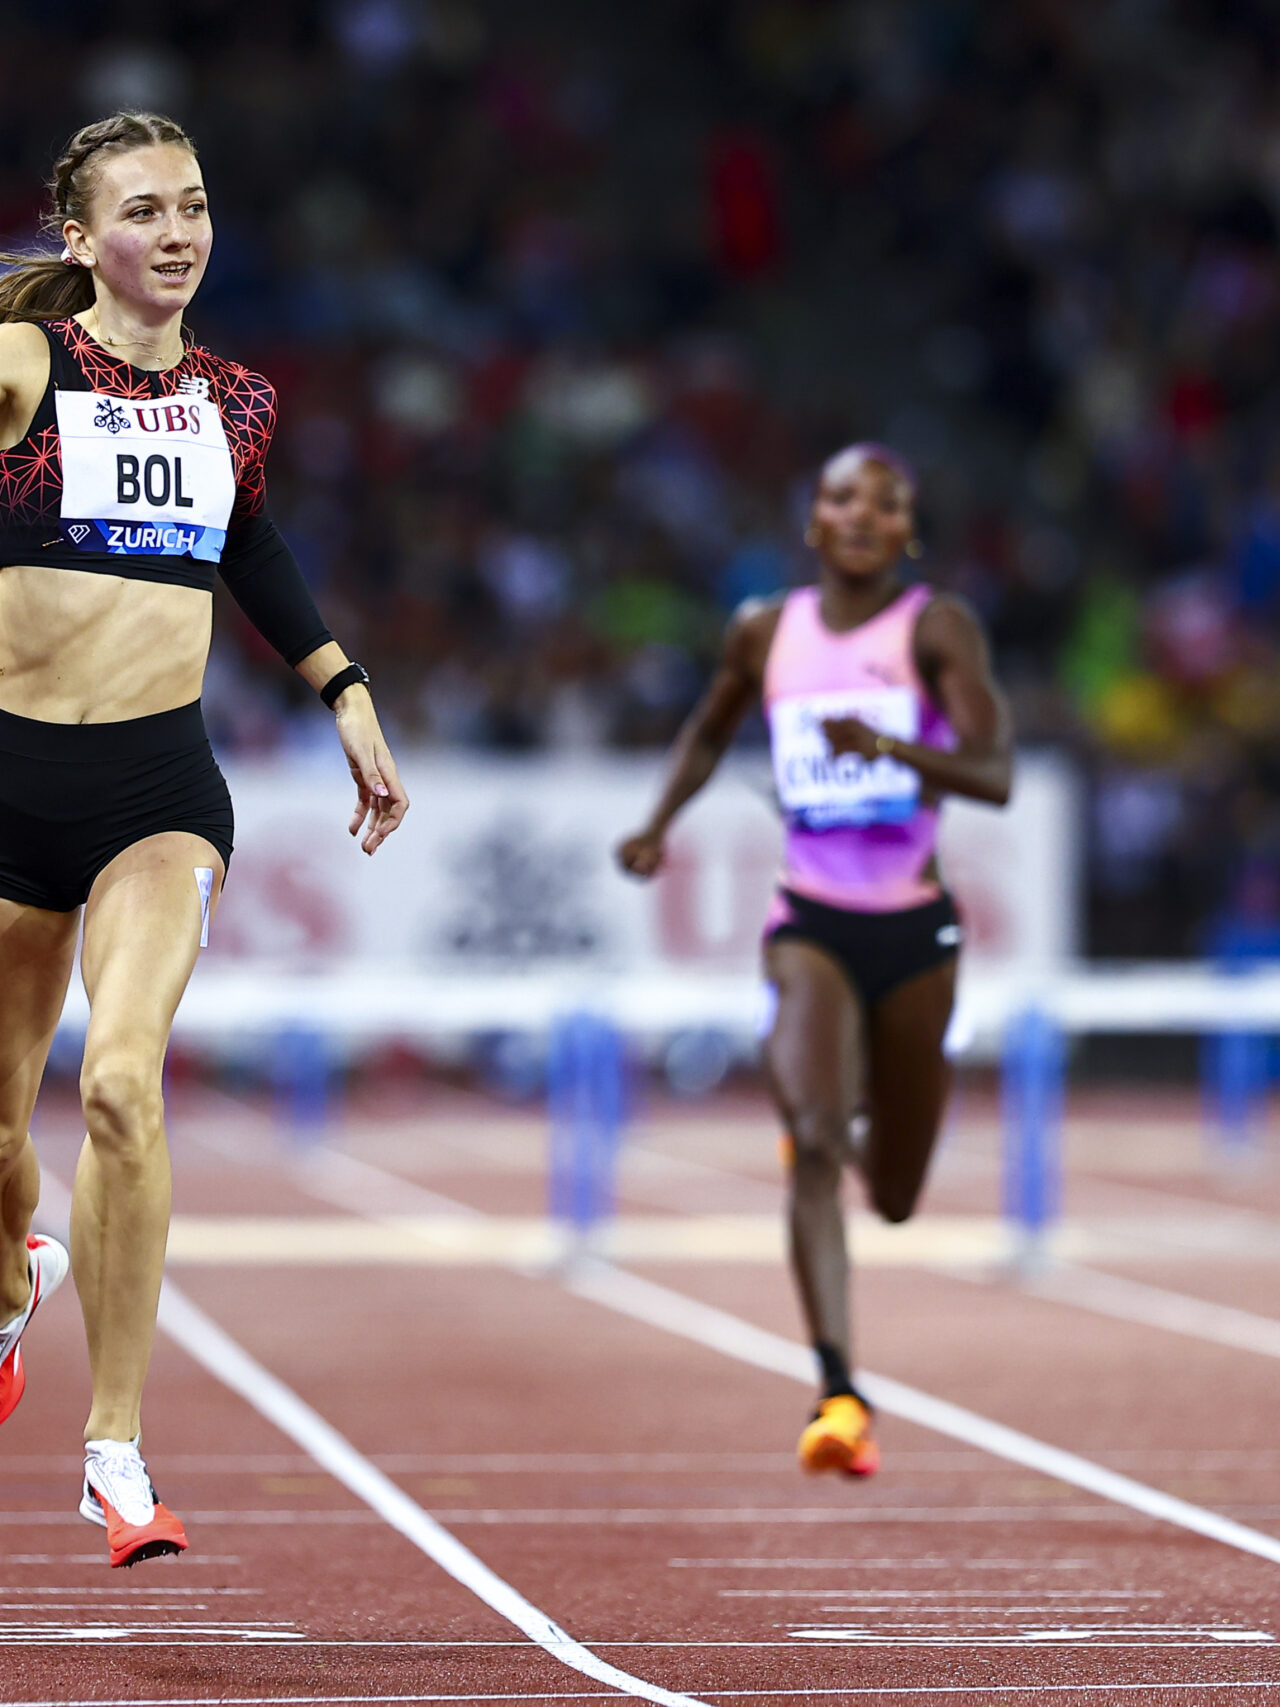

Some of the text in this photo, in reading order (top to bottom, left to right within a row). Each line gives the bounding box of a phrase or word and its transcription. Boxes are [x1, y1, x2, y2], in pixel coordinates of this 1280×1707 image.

[133, 404, 200, 435] UBS
[117, 454, 194, 508] BOL
[107, 525, 196, 550] ZURICH
